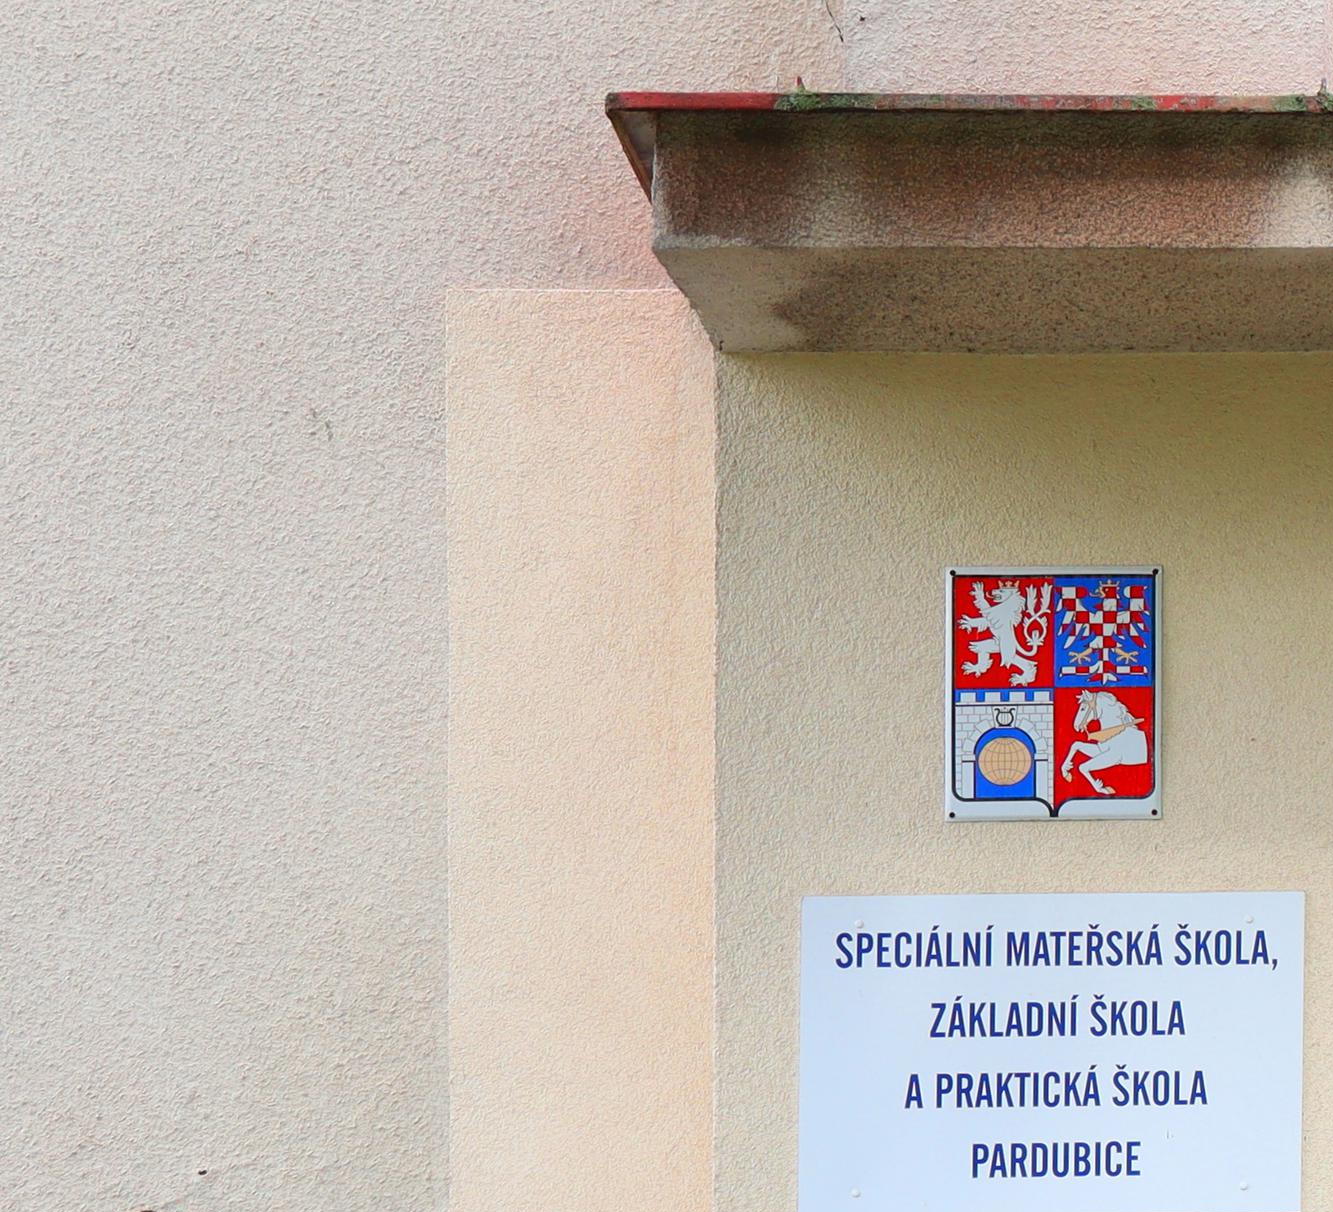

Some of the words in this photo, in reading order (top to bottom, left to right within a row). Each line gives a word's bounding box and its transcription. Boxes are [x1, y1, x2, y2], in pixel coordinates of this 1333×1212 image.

[835, 924, 995, 969] SPECIÁLNÍ
[1006, 923, 1163, 967] MATEŘSKÁ
[1174, 923, 1279, 971] ŠKOLA,
[929, 994, 1080, 1038] ZÁKLADNÍ
[1089, 994, 1187, 1037] ŠKOLA
[904, 1073, 924, 1109] A
[936, 1064, 1101, 1109] PRAKTICKÁ
[1112, 1063, 1208, 1107] ŠKOLA
[972, 1140, 1142, 1179] PARDUBICE
